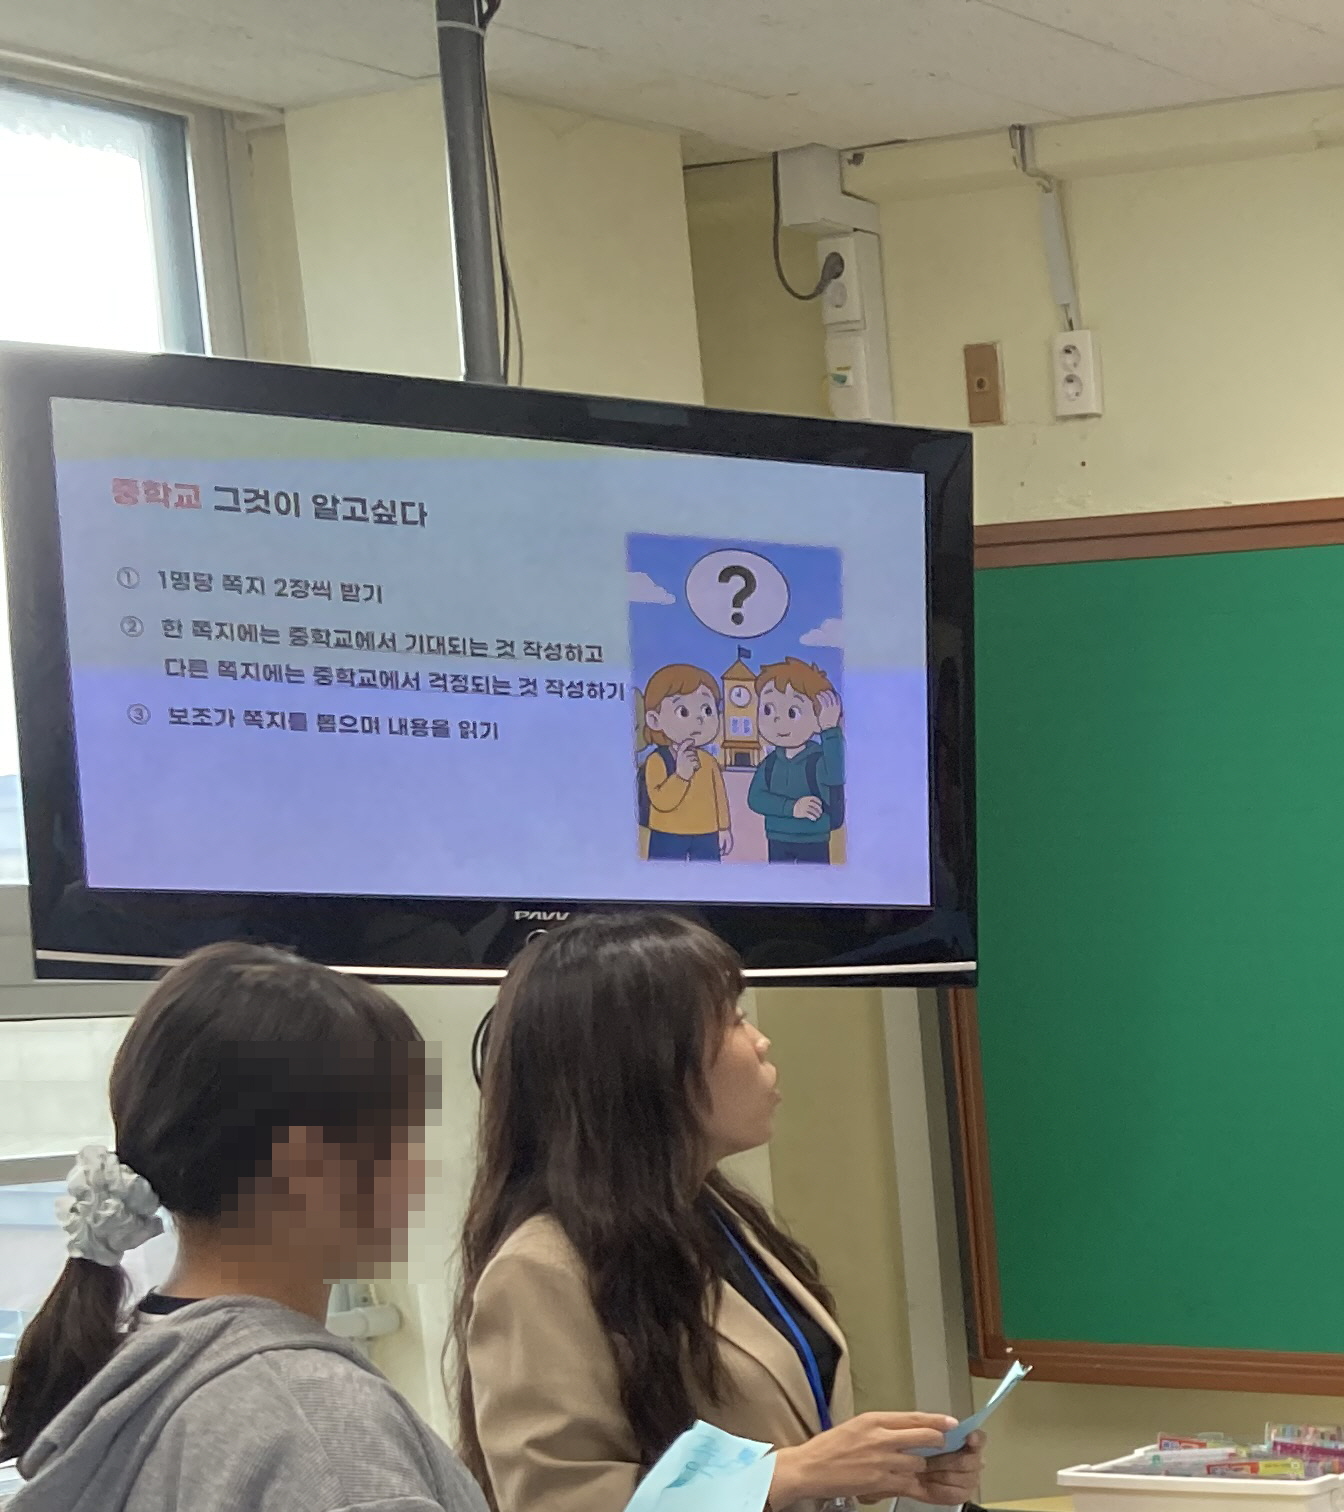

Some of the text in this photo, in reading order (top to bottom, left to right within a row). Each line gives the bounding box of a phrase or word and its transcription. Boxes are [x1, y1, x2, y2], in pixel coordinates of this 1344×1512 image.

[112, 478, 428, 528] 중학교 그것이 알고싶다
[157, 569, 214, 593] 1명당
[222, 574, 266, 596] 쪽지
[273, 578, 332, 601] 2장씩
[340, 582, 383, 604] 받기
[161, 618, 183, 639] 한
[192, 619, 281, 645] 쪽지에는
[288, 625, 396, 652] 중학교에서
[404, 633, 488, 657] 기대되는
[495, 638, 516, 659] 것
[522, 640, 604, 664] 작성하고
[164, 658, 625, 701] 다른 쪽지에는 중학교에서 걱정되는 것 작성하기
[168, 706, 236, 728] 보조가
[243, 709, 308, 731] 쪽지를
[388, 716, 450, 739] 내용을
[458, 720, 499, 741] 읽기
[514, 910, 570, 921] PAVV
